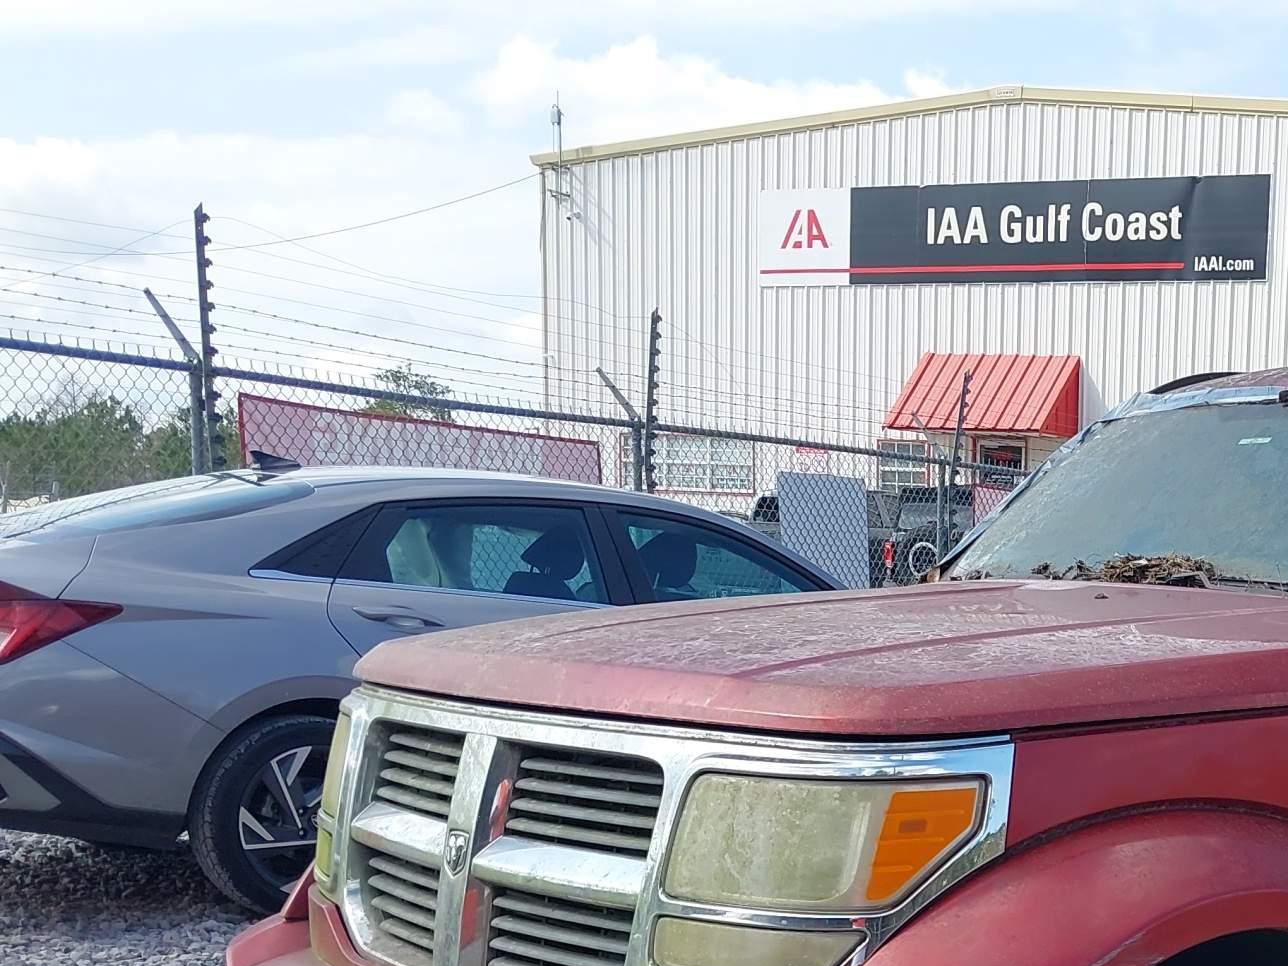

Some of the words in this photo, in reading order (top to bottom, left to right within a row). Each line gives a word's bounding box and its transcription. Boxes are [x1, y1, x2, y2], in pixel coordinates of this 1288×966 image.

[927, 206, 988, 245] IAA
[1000, 204, 1071, 244] Gulf
[1081, 202, 1182, 242] Coast
[1194, 255, 1254, 271] IAAI.com
